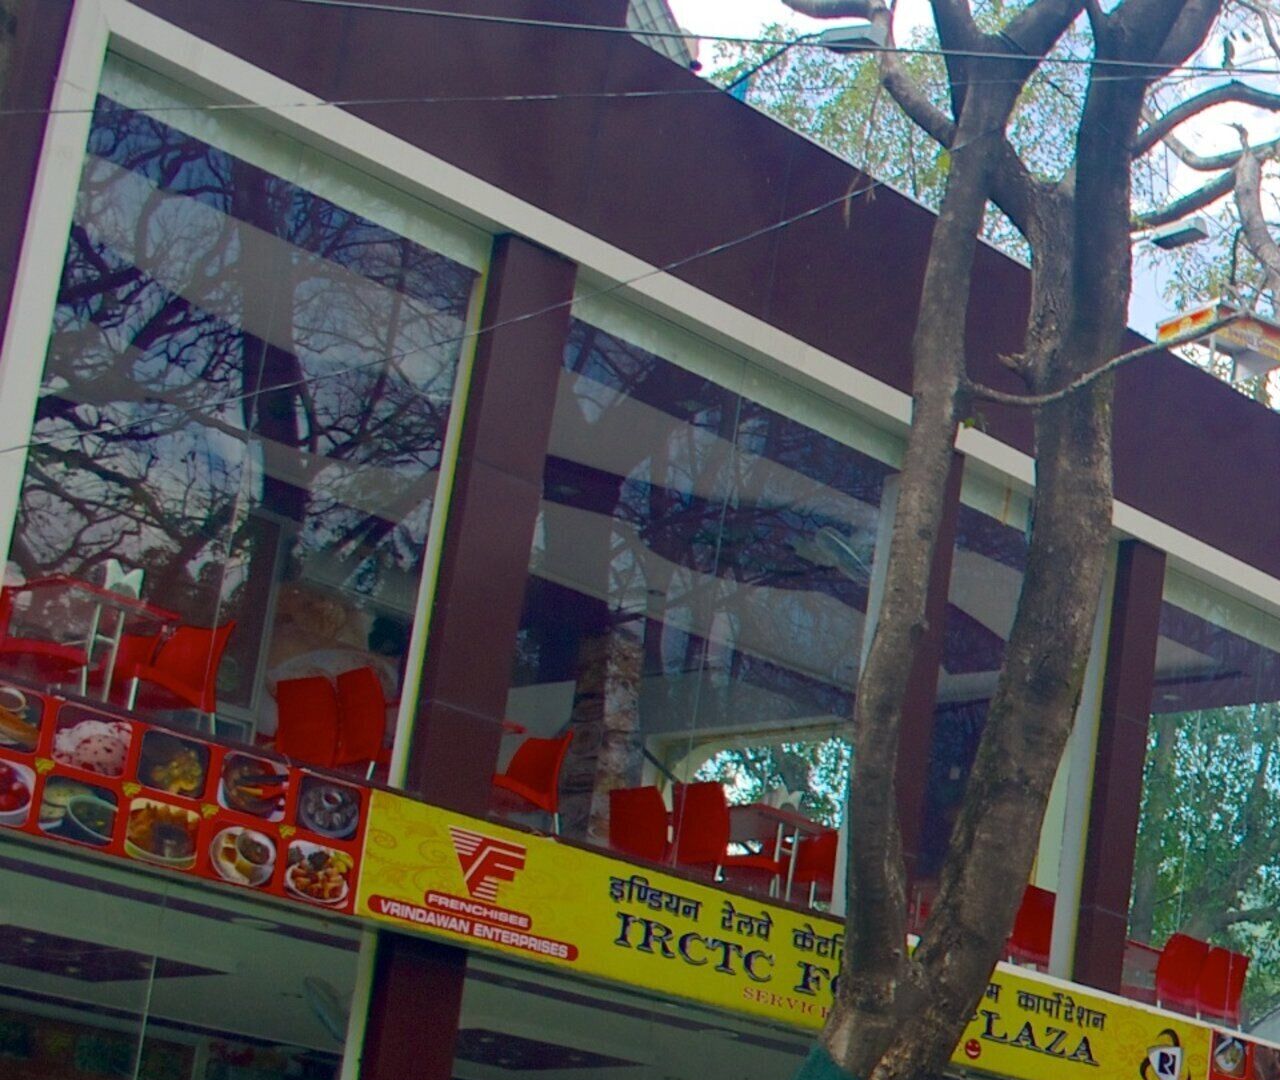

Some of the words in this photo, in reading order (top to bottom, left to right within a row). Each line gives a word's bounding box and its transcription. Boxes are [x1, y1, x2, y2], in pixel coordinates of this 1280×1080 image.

[379, 898, 470, 936] VRINDAWAN
[472, 923, 570, 960] ENTERPRISES
[613, 911, 776, 984] IRCTC
[970, 1008, 1101, 1068] LAZA
